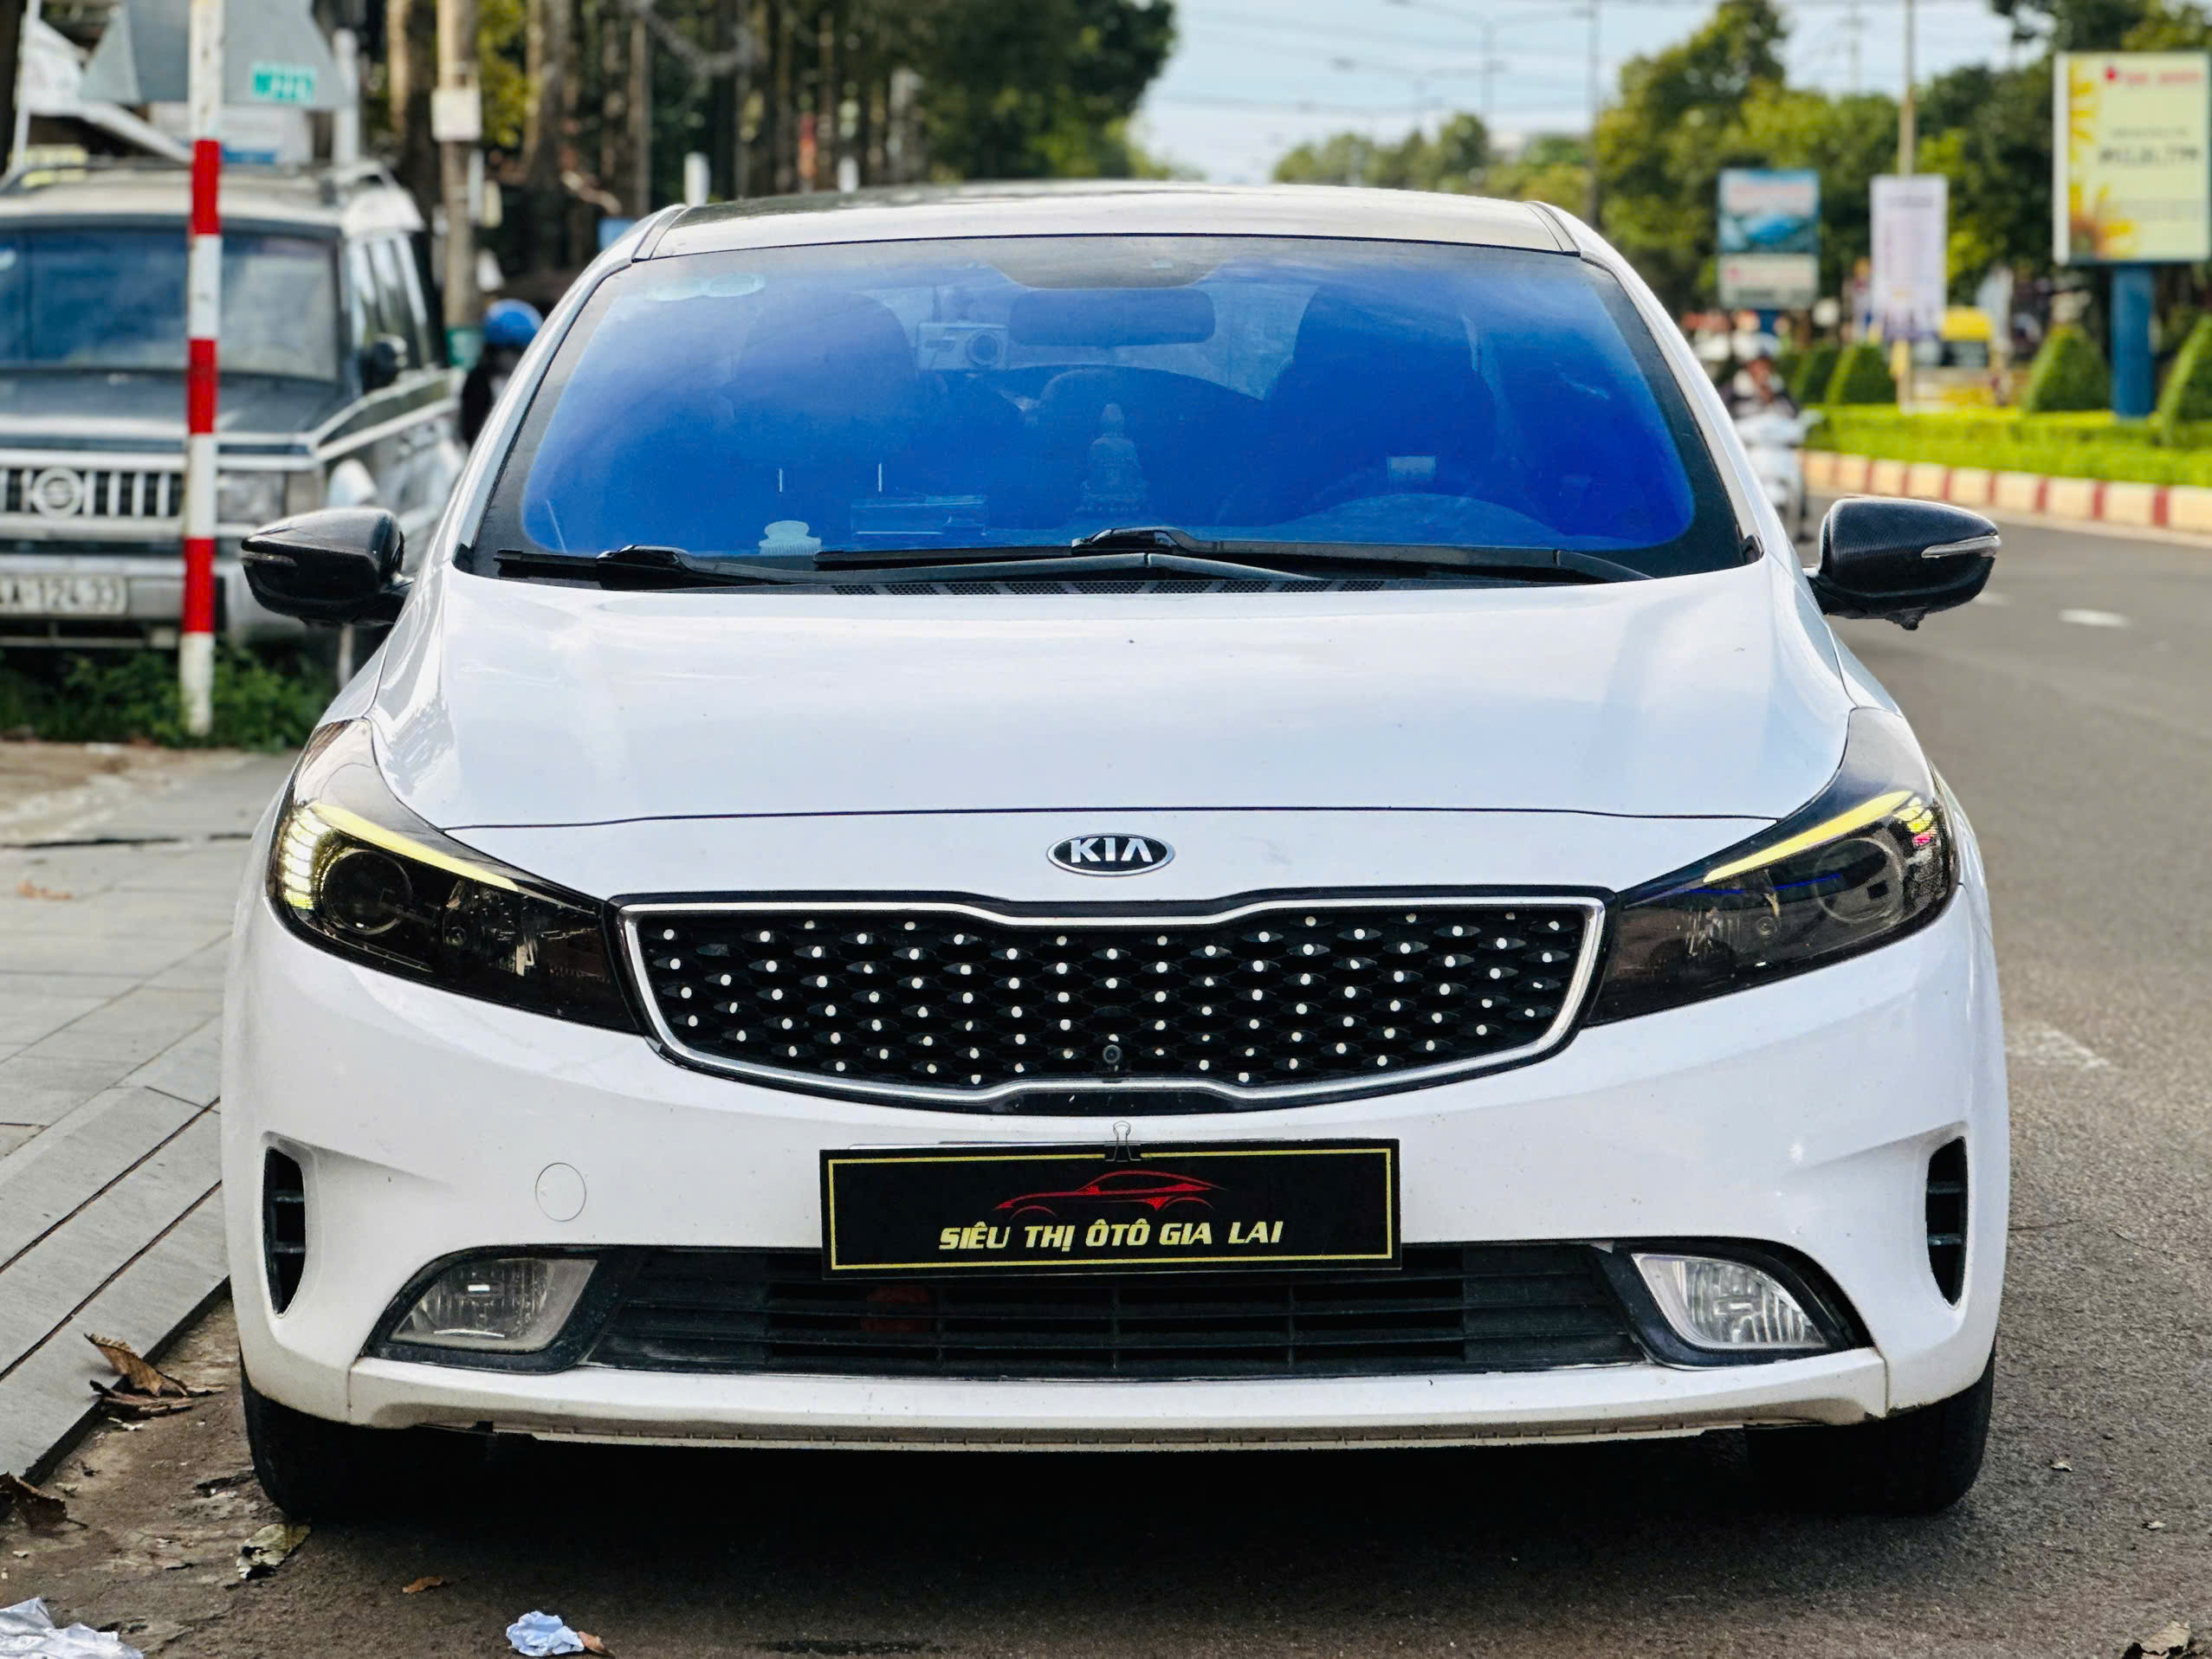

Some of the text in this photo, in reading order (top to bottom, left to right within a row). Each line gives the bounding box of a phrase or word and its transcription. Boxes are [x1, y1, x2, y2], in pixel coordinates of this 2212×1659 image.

[1070, 837, 1154, 863] KIA
[939, 1218, 1284, 1252] SIÊU THỊ ÔTÔ GIA LAI
